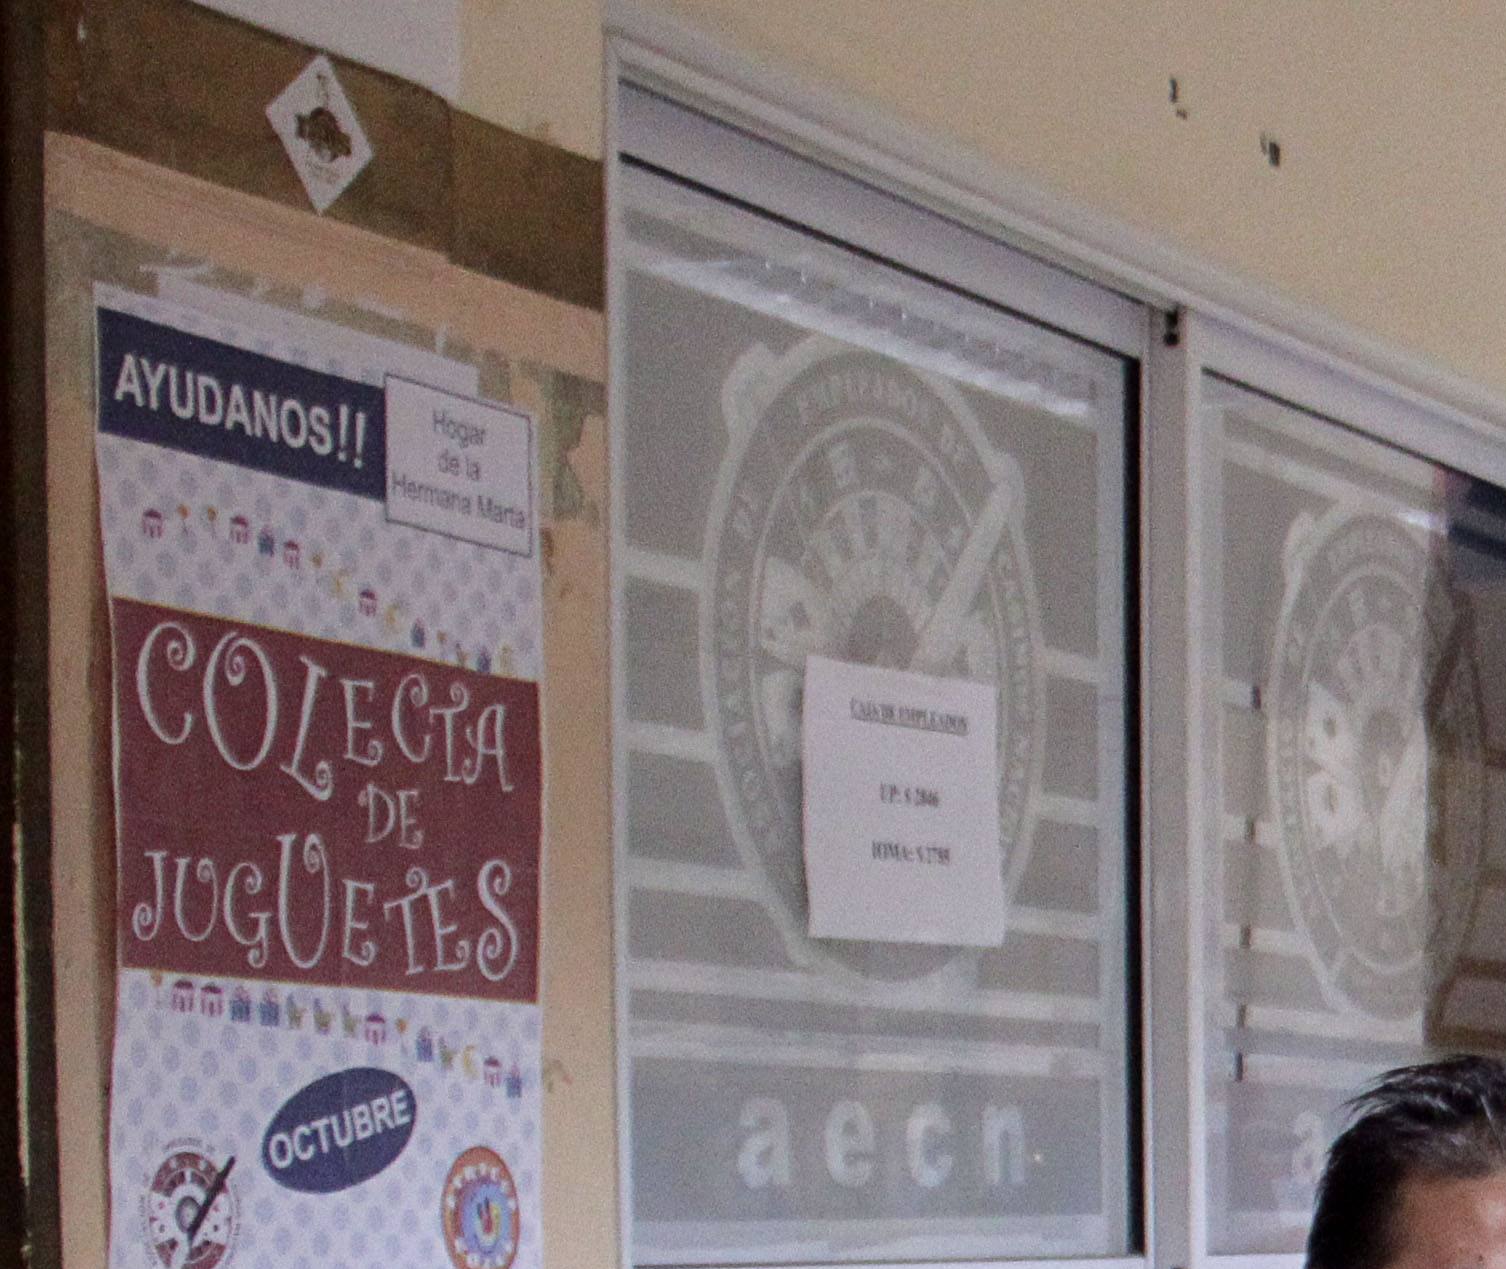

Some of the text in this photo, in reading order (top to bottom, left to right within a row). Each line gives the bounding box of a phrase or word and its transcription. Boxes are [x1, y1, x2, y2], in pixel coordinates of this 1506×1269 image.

[114, 352, 368, 469] AYUDANOS!!
[431, 408, 487, 448] Hogar
[390, 473, 527, 532] Hermana Marta
[437, 450, 481, 482] de la
[136, 622, 515, 801] COLECTA
[358, 783, 425, 849] DE
[132, 833, 519, 981] JUGUETES
[268, 1090, 412, 1169] OCTUBRE
[737, 1099, 1029, 1190] aecn
